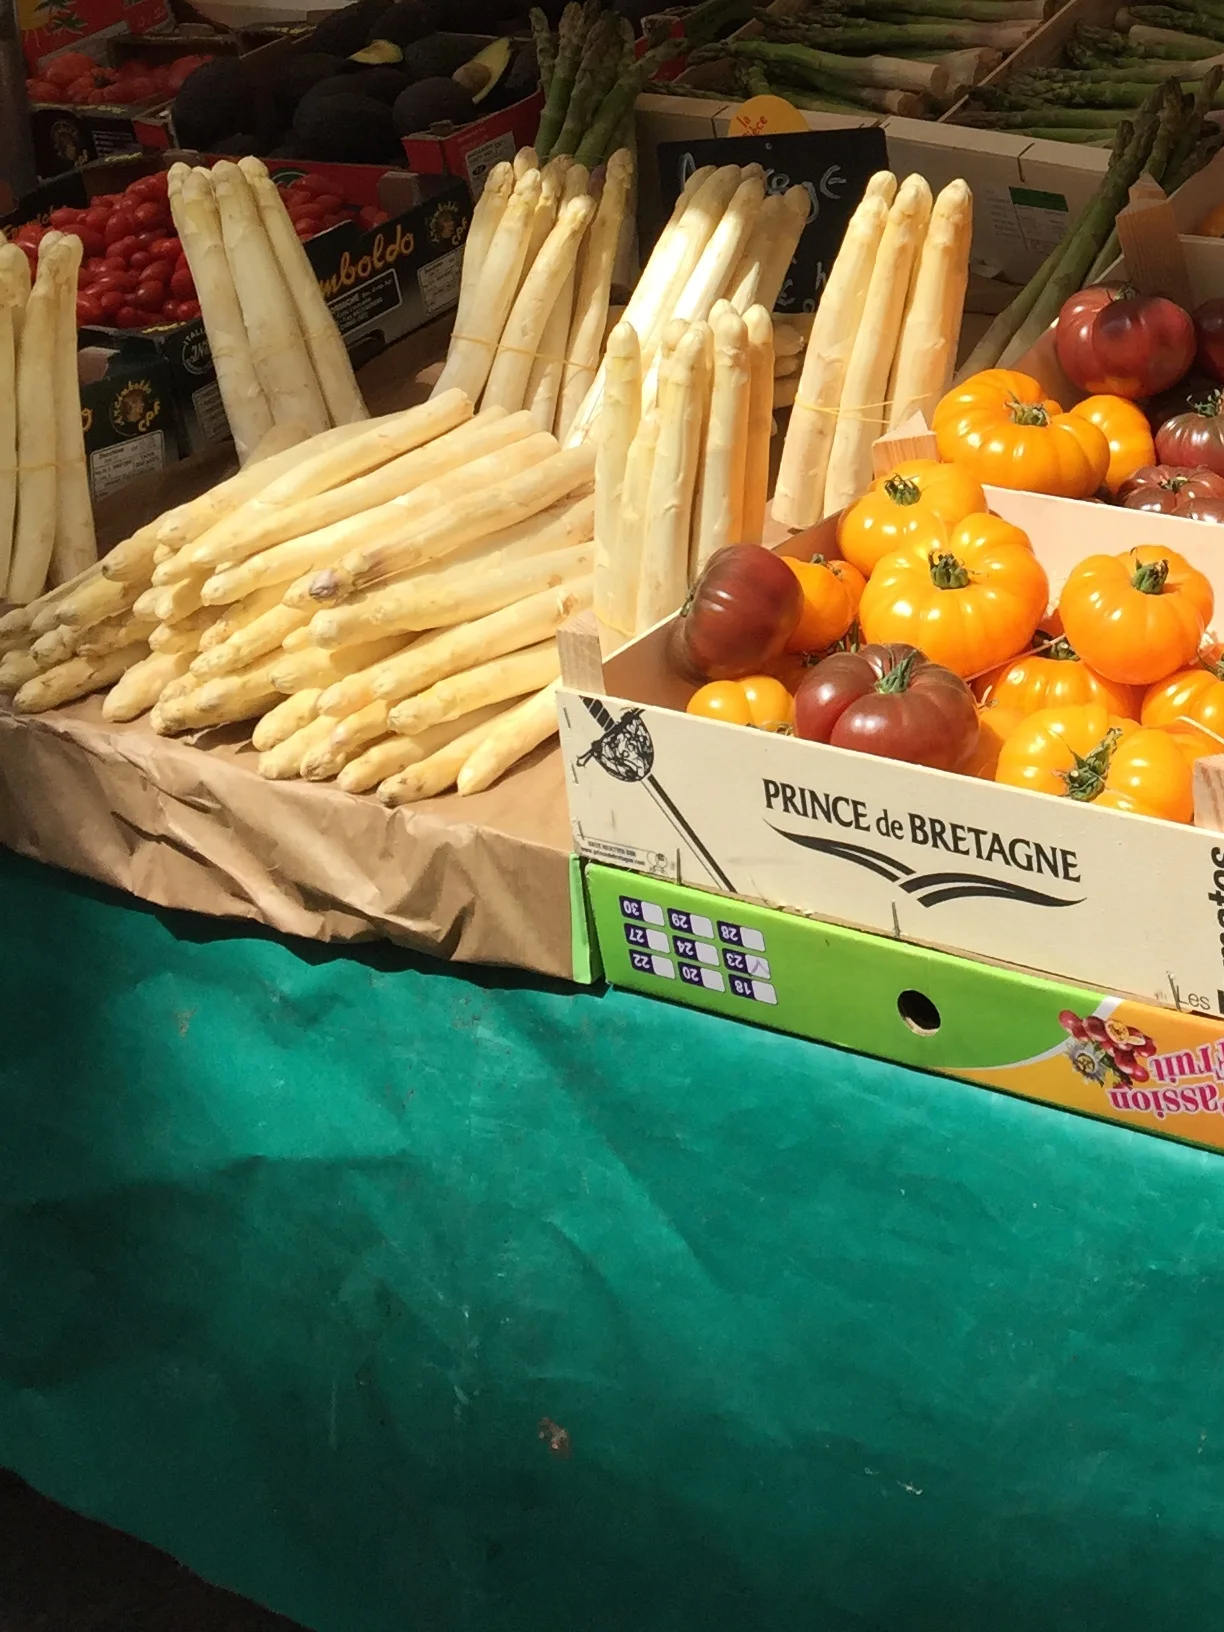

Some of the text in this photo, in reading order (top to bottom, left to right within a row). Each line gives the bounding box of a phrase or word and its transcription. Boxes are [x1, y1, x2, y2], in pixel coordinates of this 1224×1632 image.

[320, 224, 415, 297] mboldo
[762, 778, 1080, 882] PRINCE de BRETAGNE
[623, 900, 738, 941] 28 29 30
[629, 928, 744, 968] 23 24 27
[632, 954, 751, 995] 18 20 22
[1178, 987, 1210, 1010] Les
